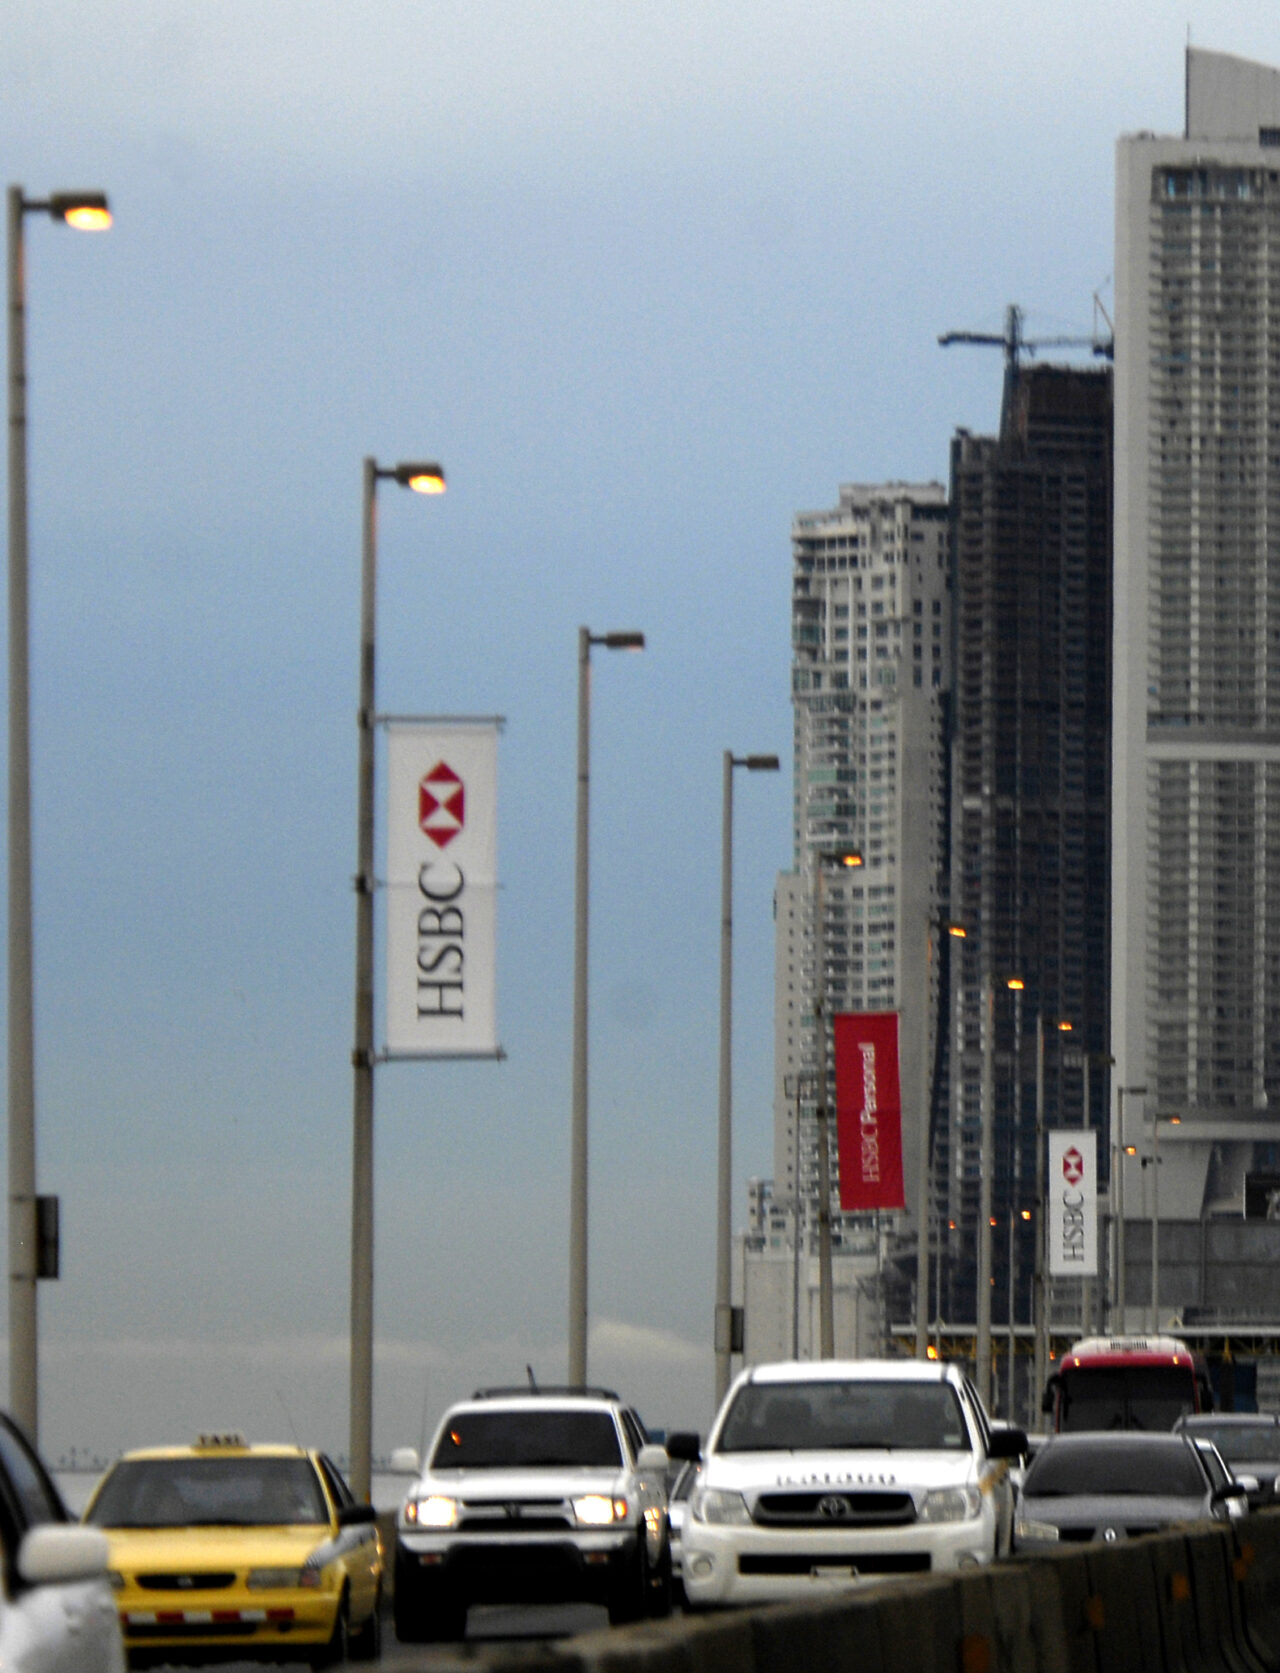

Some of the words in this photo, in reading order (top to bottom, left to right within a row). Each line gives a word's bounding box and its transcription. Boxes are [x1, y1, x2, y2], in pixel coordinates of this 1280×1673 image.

[416, 861, 465, 1022] HSBC
[858, 1041, 878, 1124] Personal
[860, 1125, 881, 1183] HSBC
[1062, 1190, 1085, 1263] HSBC
